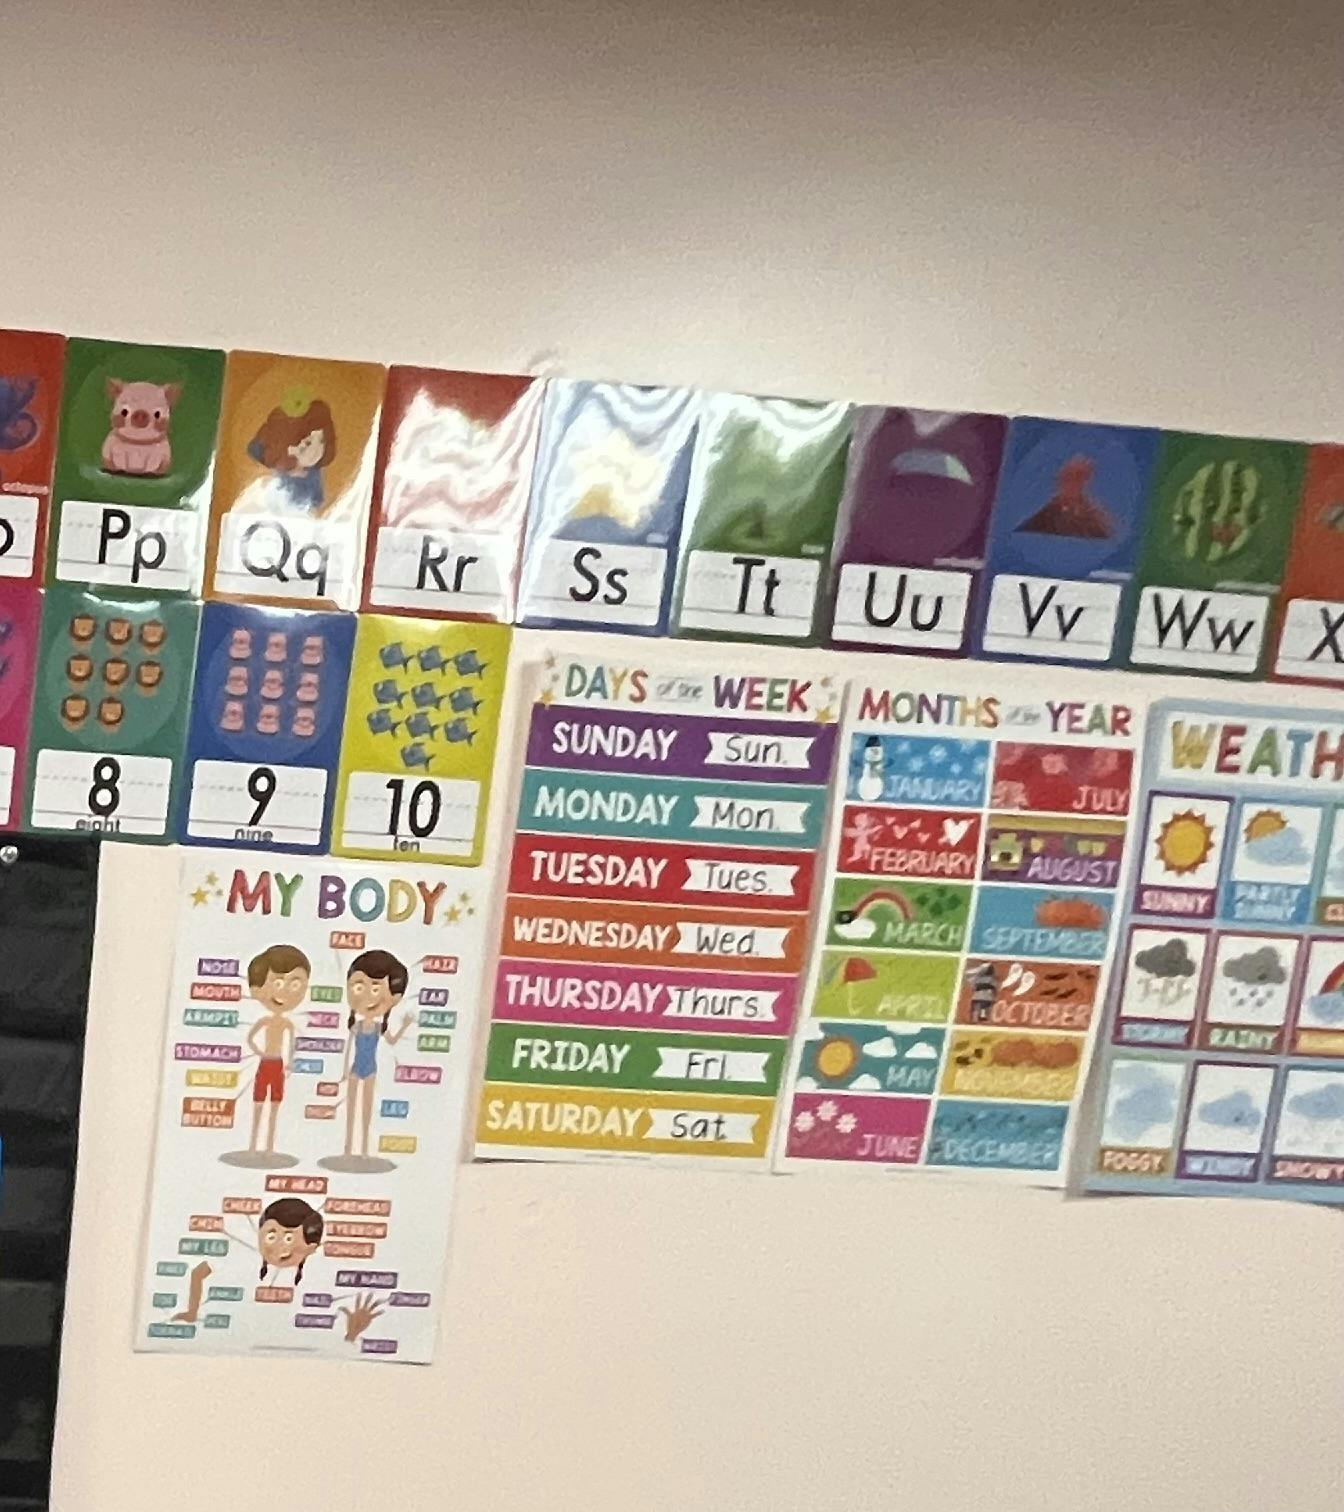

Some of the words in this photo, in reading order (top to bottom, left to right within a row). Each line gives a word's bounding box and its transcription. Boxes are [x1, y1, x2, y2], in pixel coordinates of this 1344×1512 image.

[99, 509, 165, 582] Pp
[417, 536, 478, 592] Rr
[570, 548, 627, 605] Ss
[732, 556, 780, 617] Tt
[864, 572, 943, 632] Uu
[1018, 583, 1082, 640] Vv
[1153, 594, 1253, 653] Ww
[565, 663, 648, 702] DAYS
[714, 677, 812, 713] WEEK
[859, 687, 999, 728] MONTHS
[1046, 701, 1133, 736] YEAR
[552, 721, 678, 761] SUNDAY
[723, 737, 788, 766] Sun.
[90, 756, 120, 815] 8
[247, 767, 276, 825] 9
[385, 777, 441, 837] 10
[533, 786, 678, 826] MONDAY
[1073, 786, 1128, 811] JULY
[530, 850, 668, 890] TUESDAY
[704, 862, 773, 892] Tues.
[871, 846, 975, 873] FEBRUARY
[1029, 857, 1116, 883] AUGUST
[227, 870, 303, 917] MY
[319, 875, 447, 925] BODY
[513, 916, 672, 951] WEDNESDAY
[696, 926, 760, 957] Wed.
[505, 974, 662, 1014] THURSDAY
[674, 987, 766, 1019] Thurs.
[992, 1002, 1089, 1028] OCTOBER
[512, 1039, 630, 1073] FRIDAY
[486, 1100, 644, 1135] SATURDAY
